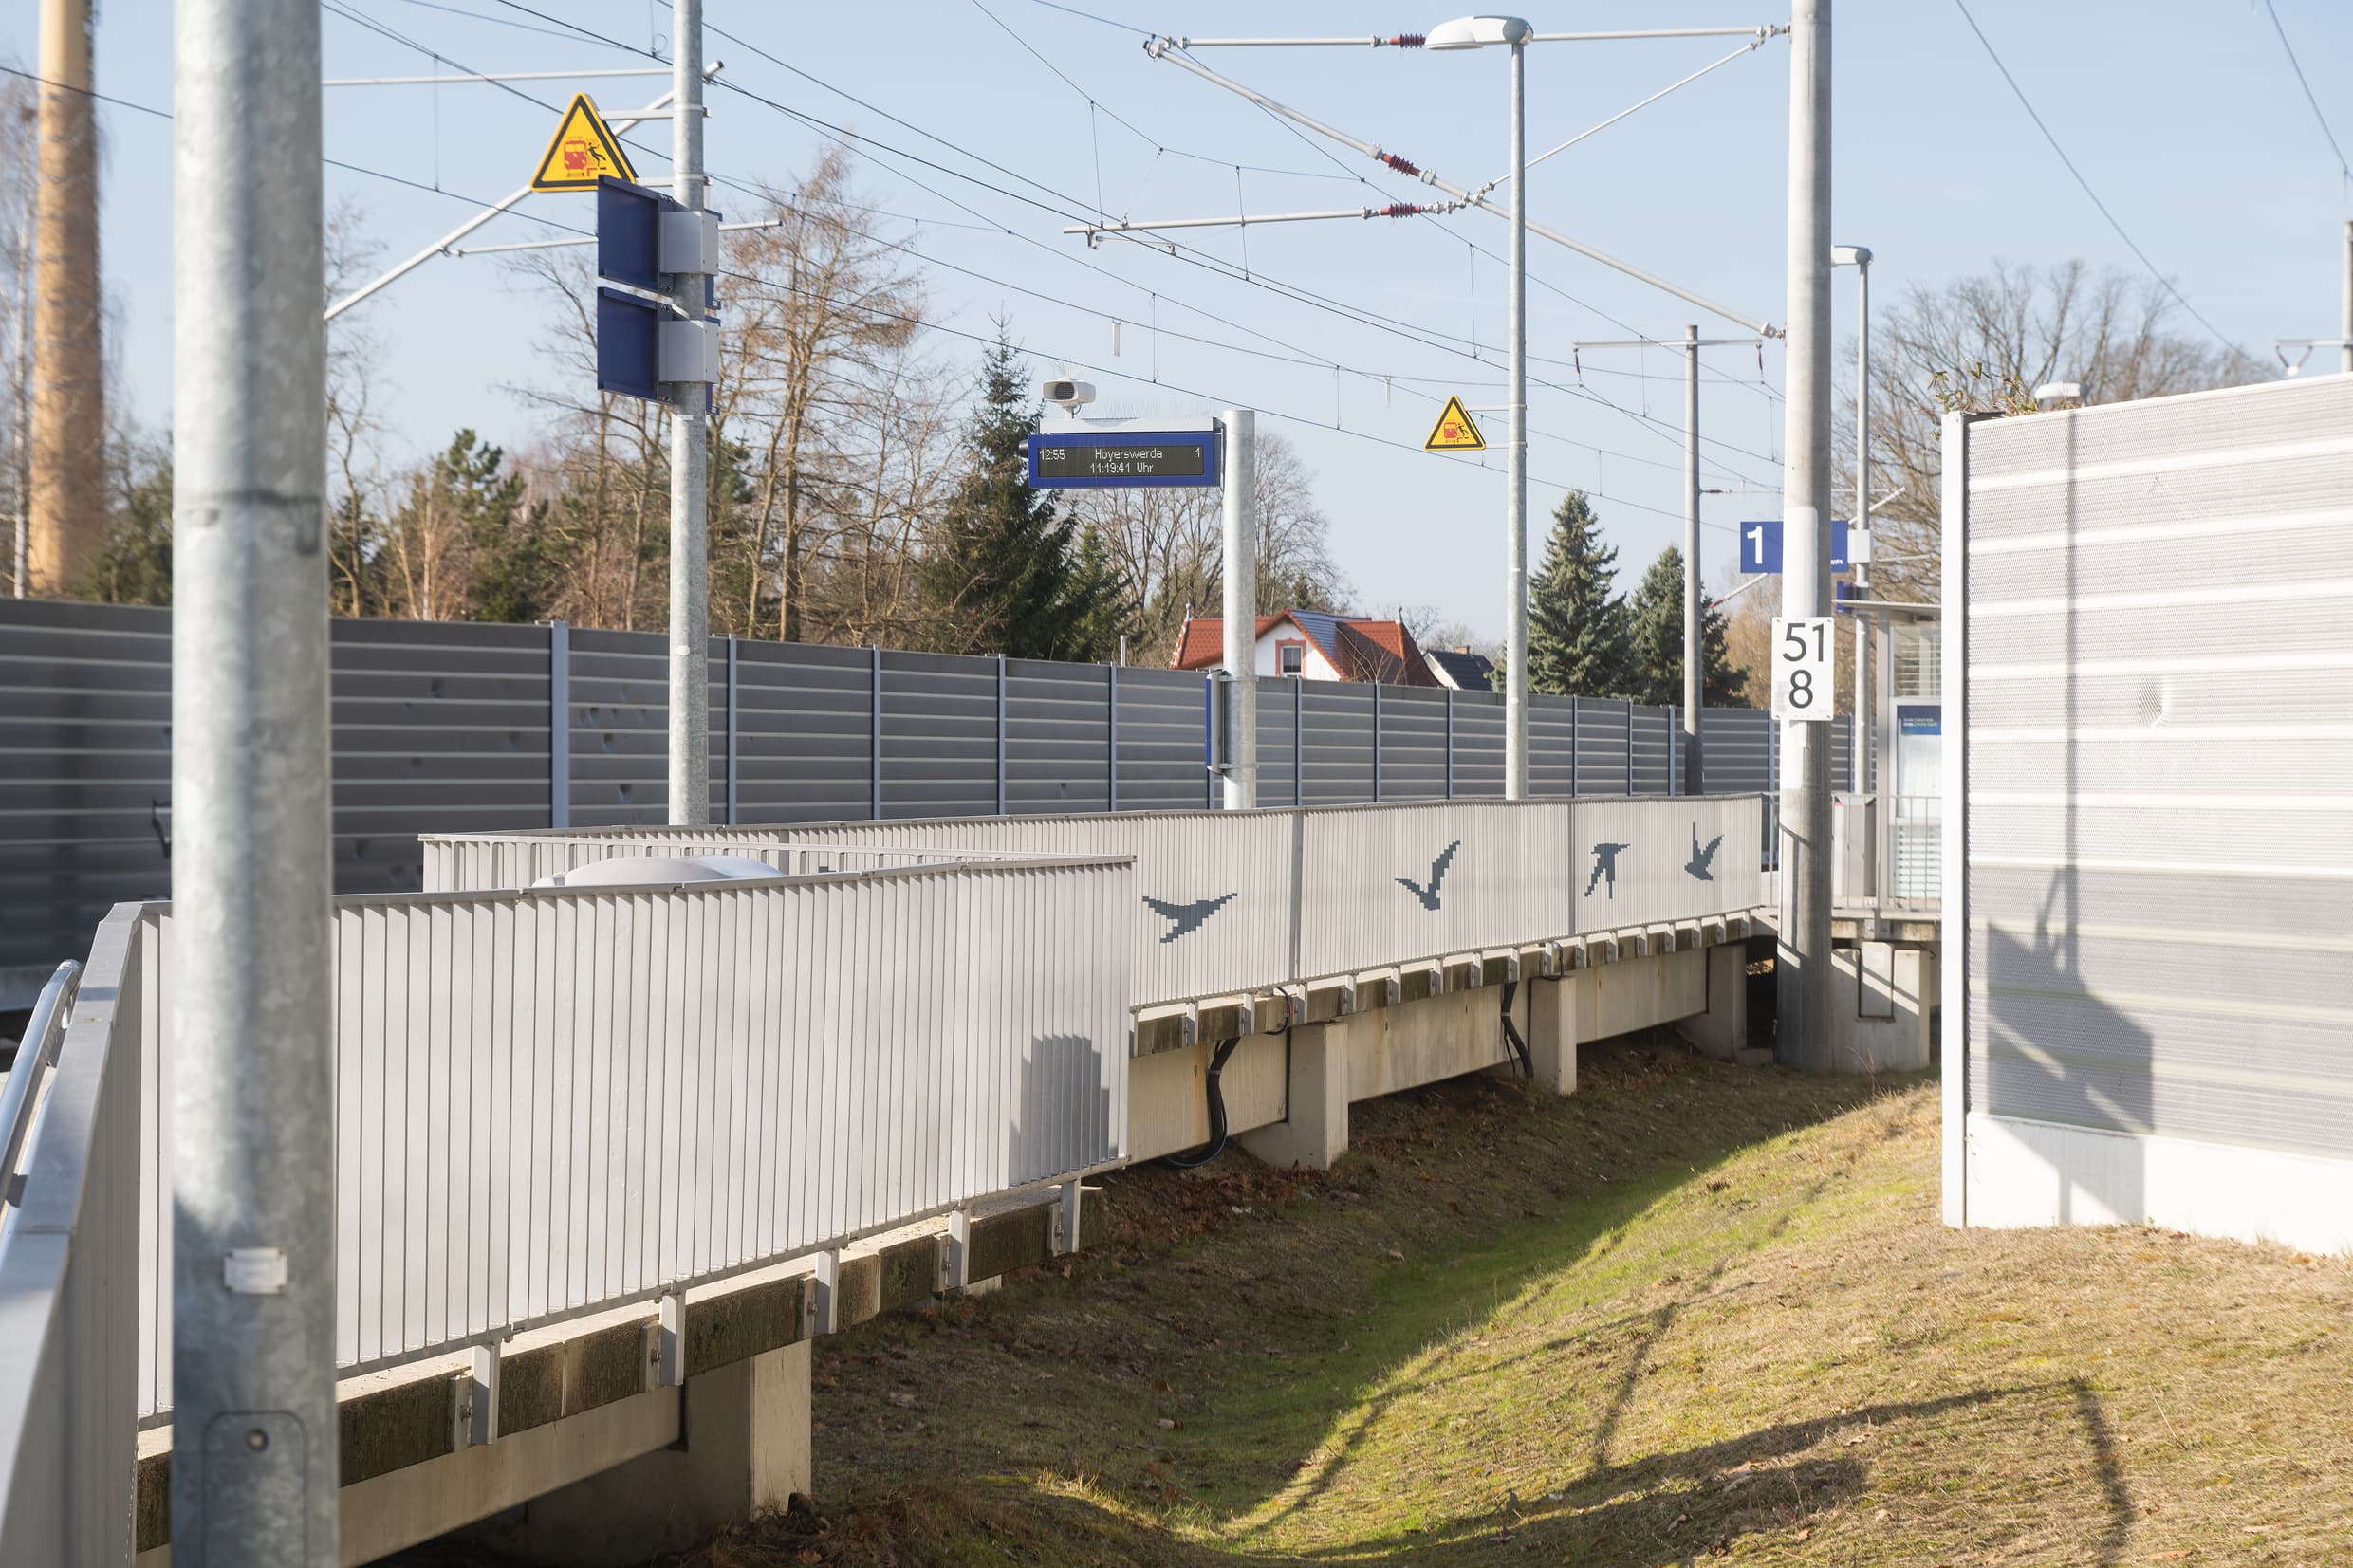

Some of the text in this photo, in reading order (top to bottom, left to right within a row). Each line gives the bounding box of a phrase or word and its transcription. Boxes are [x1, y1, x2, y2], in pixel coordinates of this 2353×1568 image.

[1040, 447, 1200, 461] 12:55 Hoyerswerda 1
[1090, 462, 1154, 473] 11:19:41 Uhr
[1747, 526, 1763, 564] 1
[1783, 622, 1824, 662] 51
[1788, 670, 1813, 709] 8
